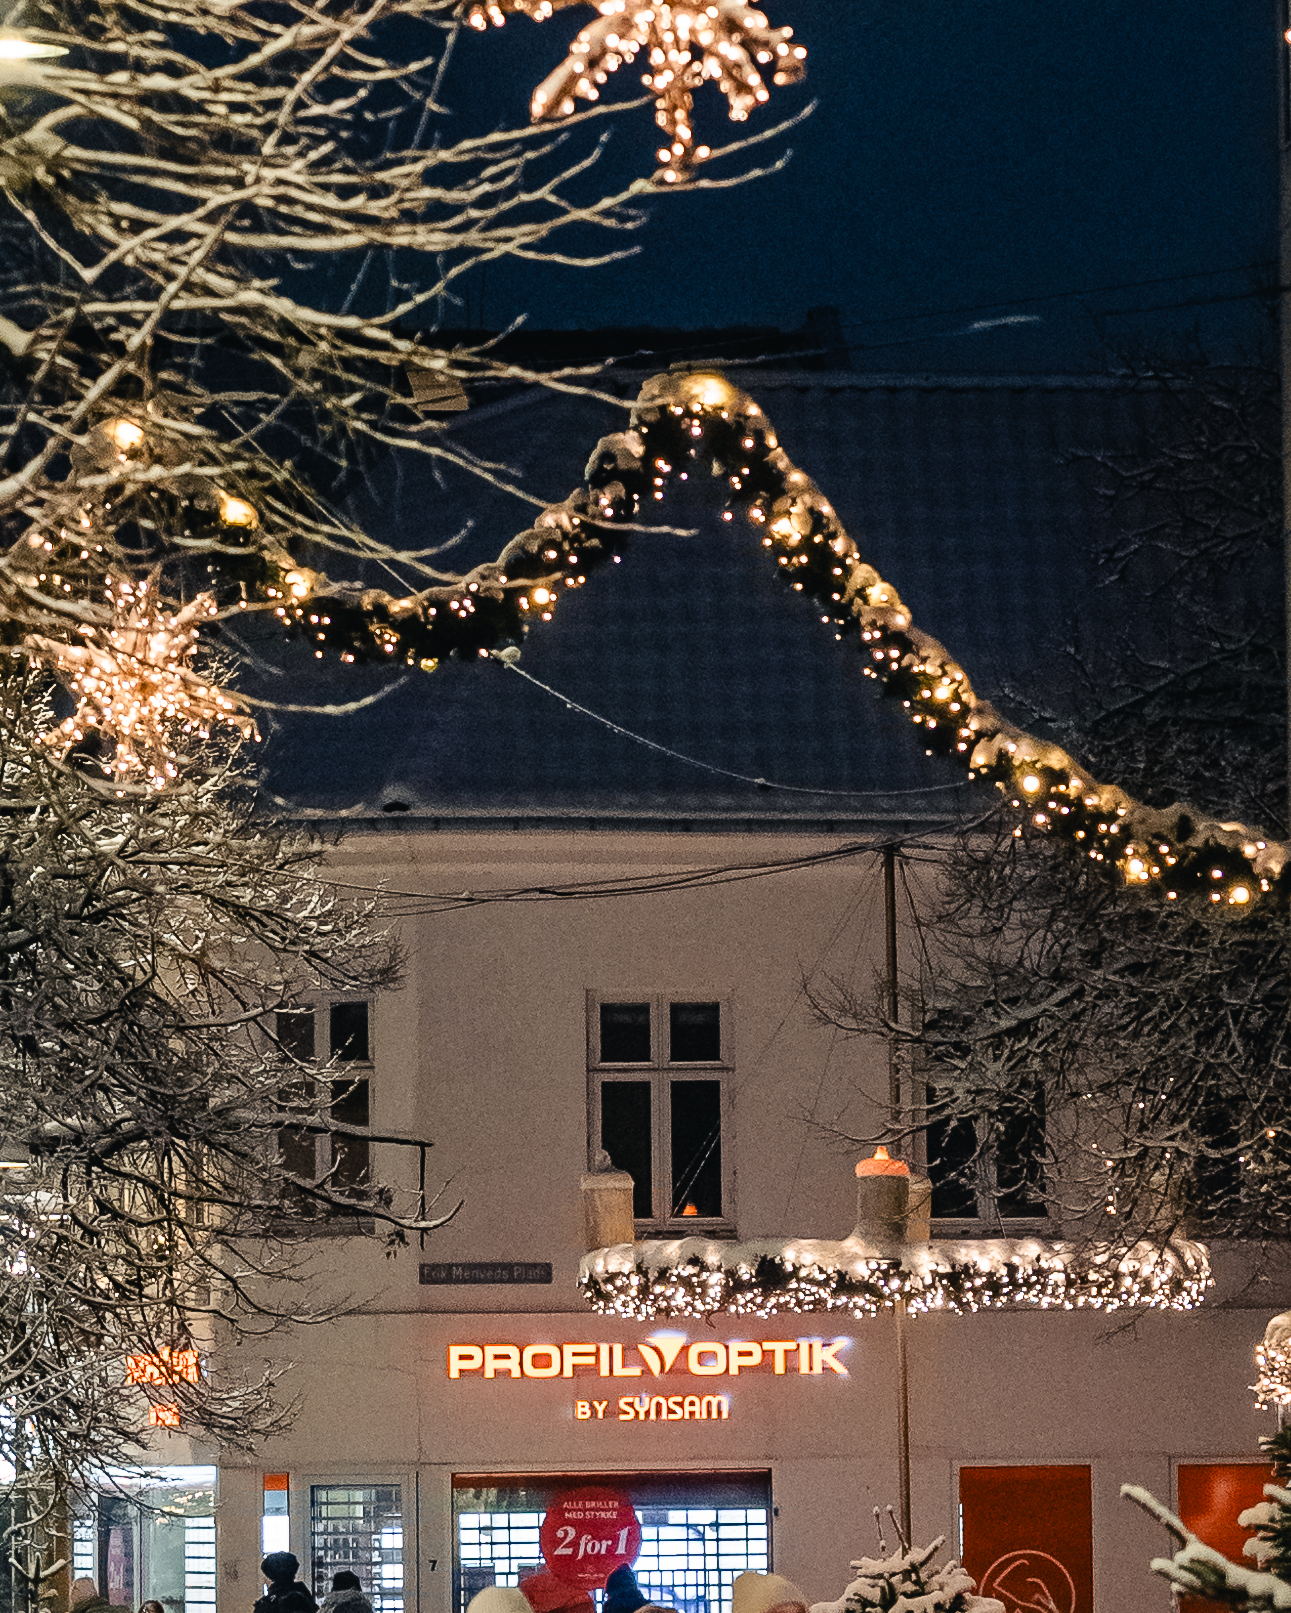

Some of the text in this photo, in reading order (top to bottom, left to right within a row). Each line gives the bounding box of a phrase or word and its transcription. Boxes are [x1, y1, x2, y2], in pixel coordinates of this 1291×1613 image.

[424, 1267, 447, 1280] Erik
[452, 1267, 509, 1280] Menveds
[448, 1340, 849, 1379] PROFIL OPTIK
[576, 1395, 729, 1421] BY SYNSAM
[585, 1500, 619, 1508] BRILLER
[564, 1511, 618, 1519] MED STYRKE
[553, 1526, 630, 1561] 2 for 1
[428, 1559, 438, 1572] 7
